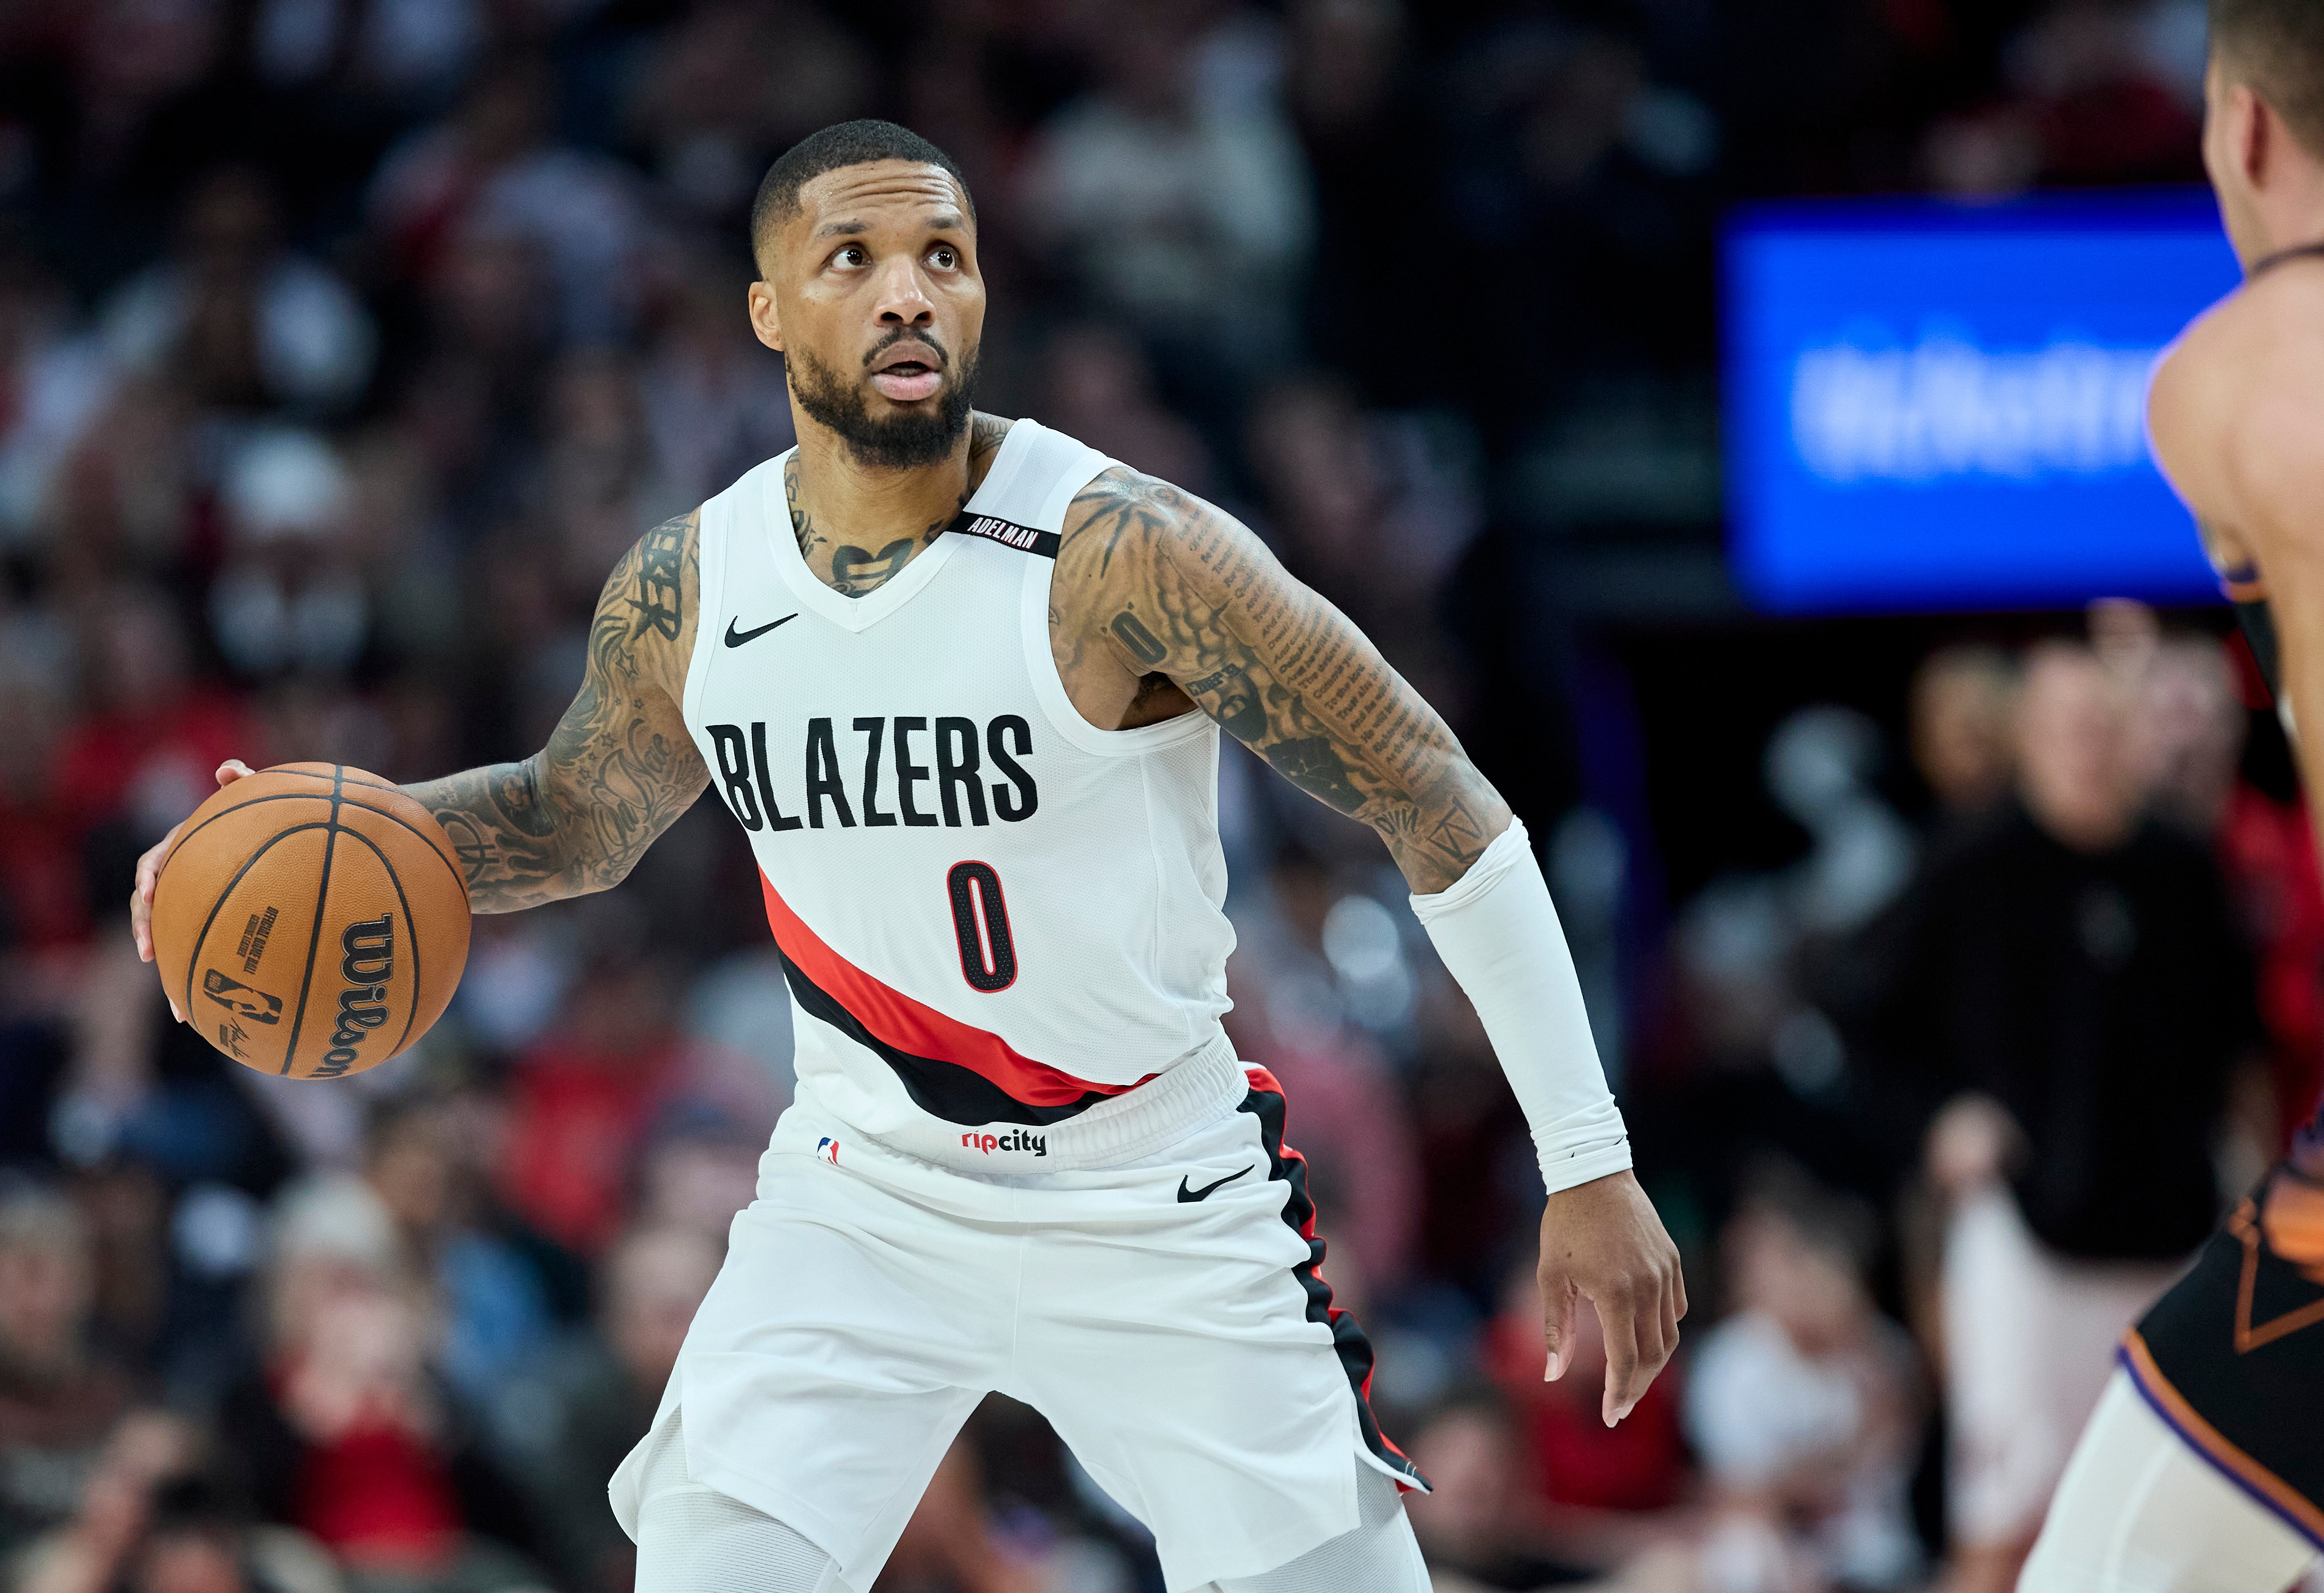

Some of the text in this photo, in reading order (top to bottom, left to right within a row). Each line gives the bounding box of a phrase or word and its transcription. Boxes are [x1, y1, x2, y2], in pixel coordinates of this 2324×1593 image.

[967, 517, 1038, 549] ADELMAN
[1111, 609, 1168, 666] 0
[705, 714, 1038, 832] BLAZERS
[243, 905, 279, 975] OFFICIAL GAME BALL
[947, 859, 1018, 993] 0
[306, 913, 393, 1078] Wilson
[962, 1129, 1047, 1157] ripcity
